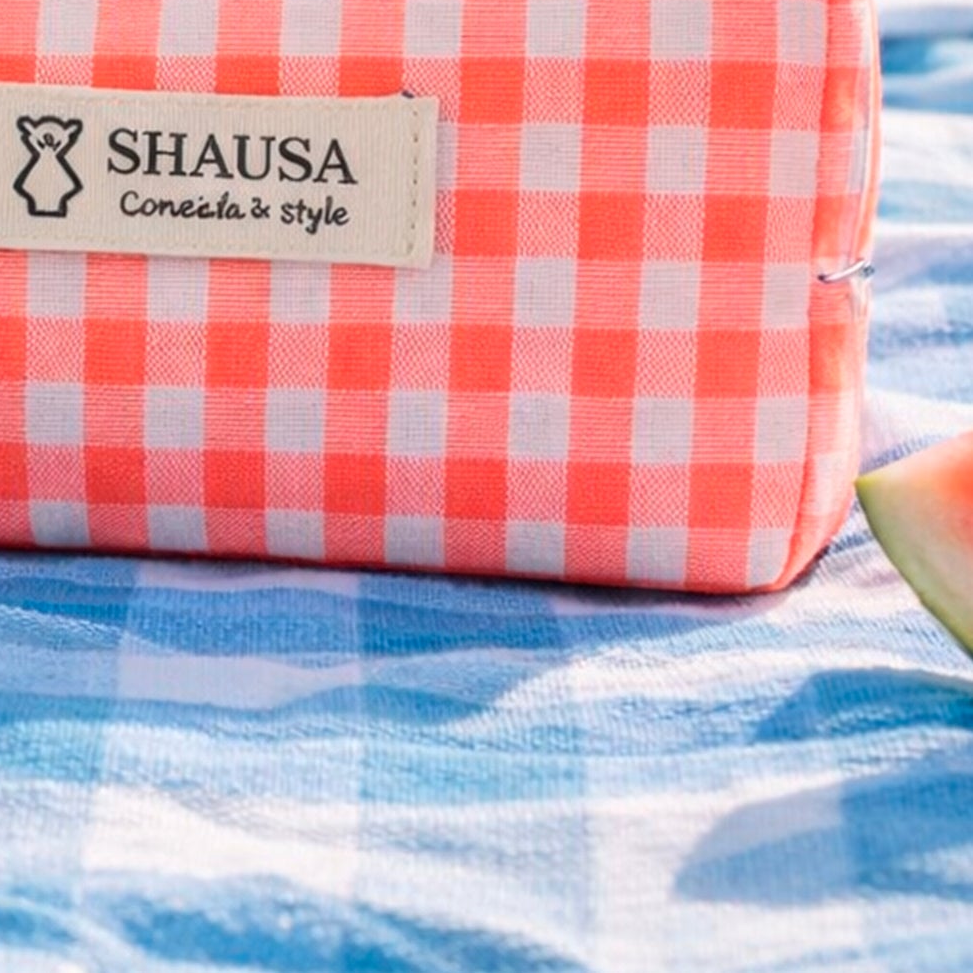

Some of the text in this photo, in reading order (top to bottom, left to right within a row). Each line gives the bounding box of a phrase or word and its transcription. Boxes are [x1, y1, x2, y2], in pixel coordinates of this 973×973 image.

[106, 127, 359, 185] SHAUSA
[250, 196, 271, 220] &
[280, 197, 350, 236] style
